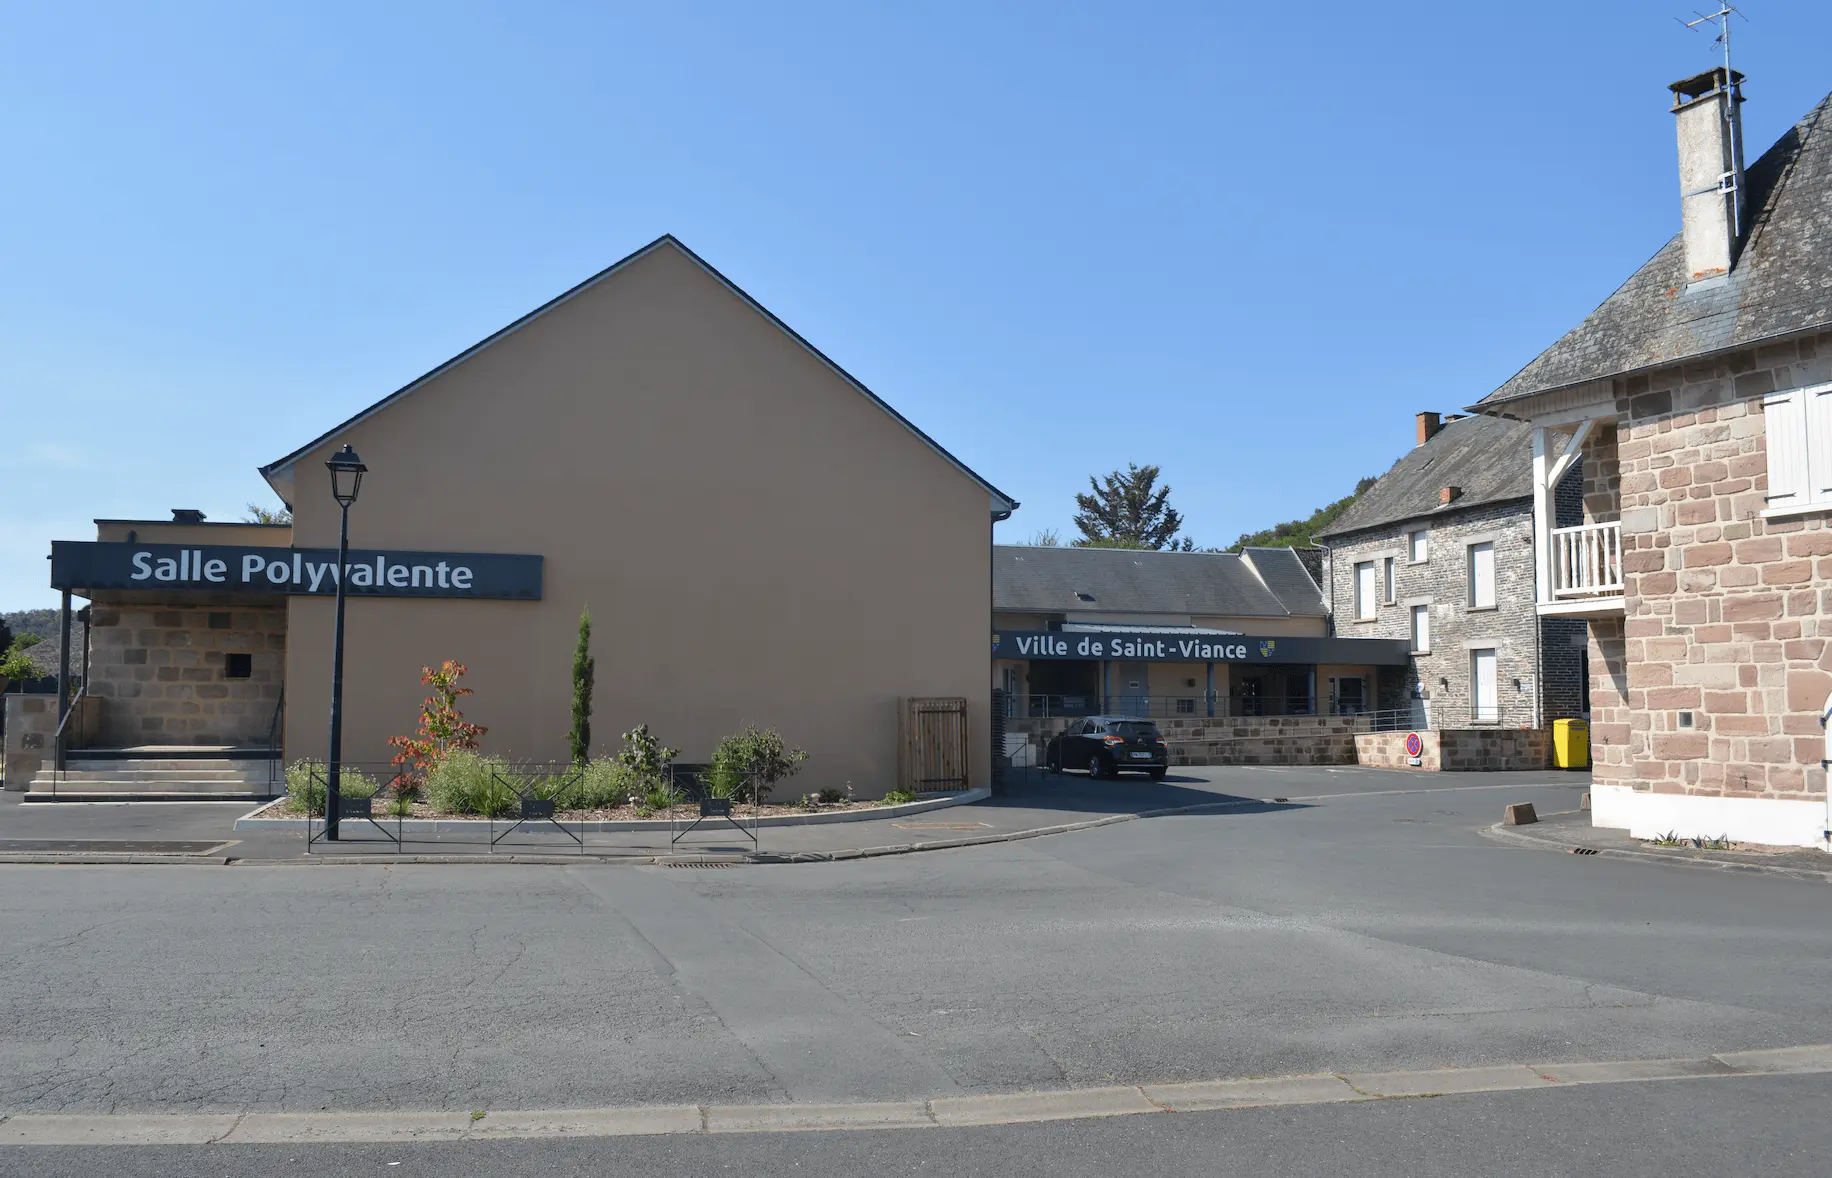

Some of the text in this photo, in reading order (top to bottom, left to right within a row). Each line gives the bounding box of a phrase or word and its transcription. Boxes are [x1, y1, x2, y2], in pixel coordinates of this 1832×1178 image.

[130, 549, 474, 592] Salle Polyvalente
[1016, 636, 1247, 659] Ville de Saint-Viance
